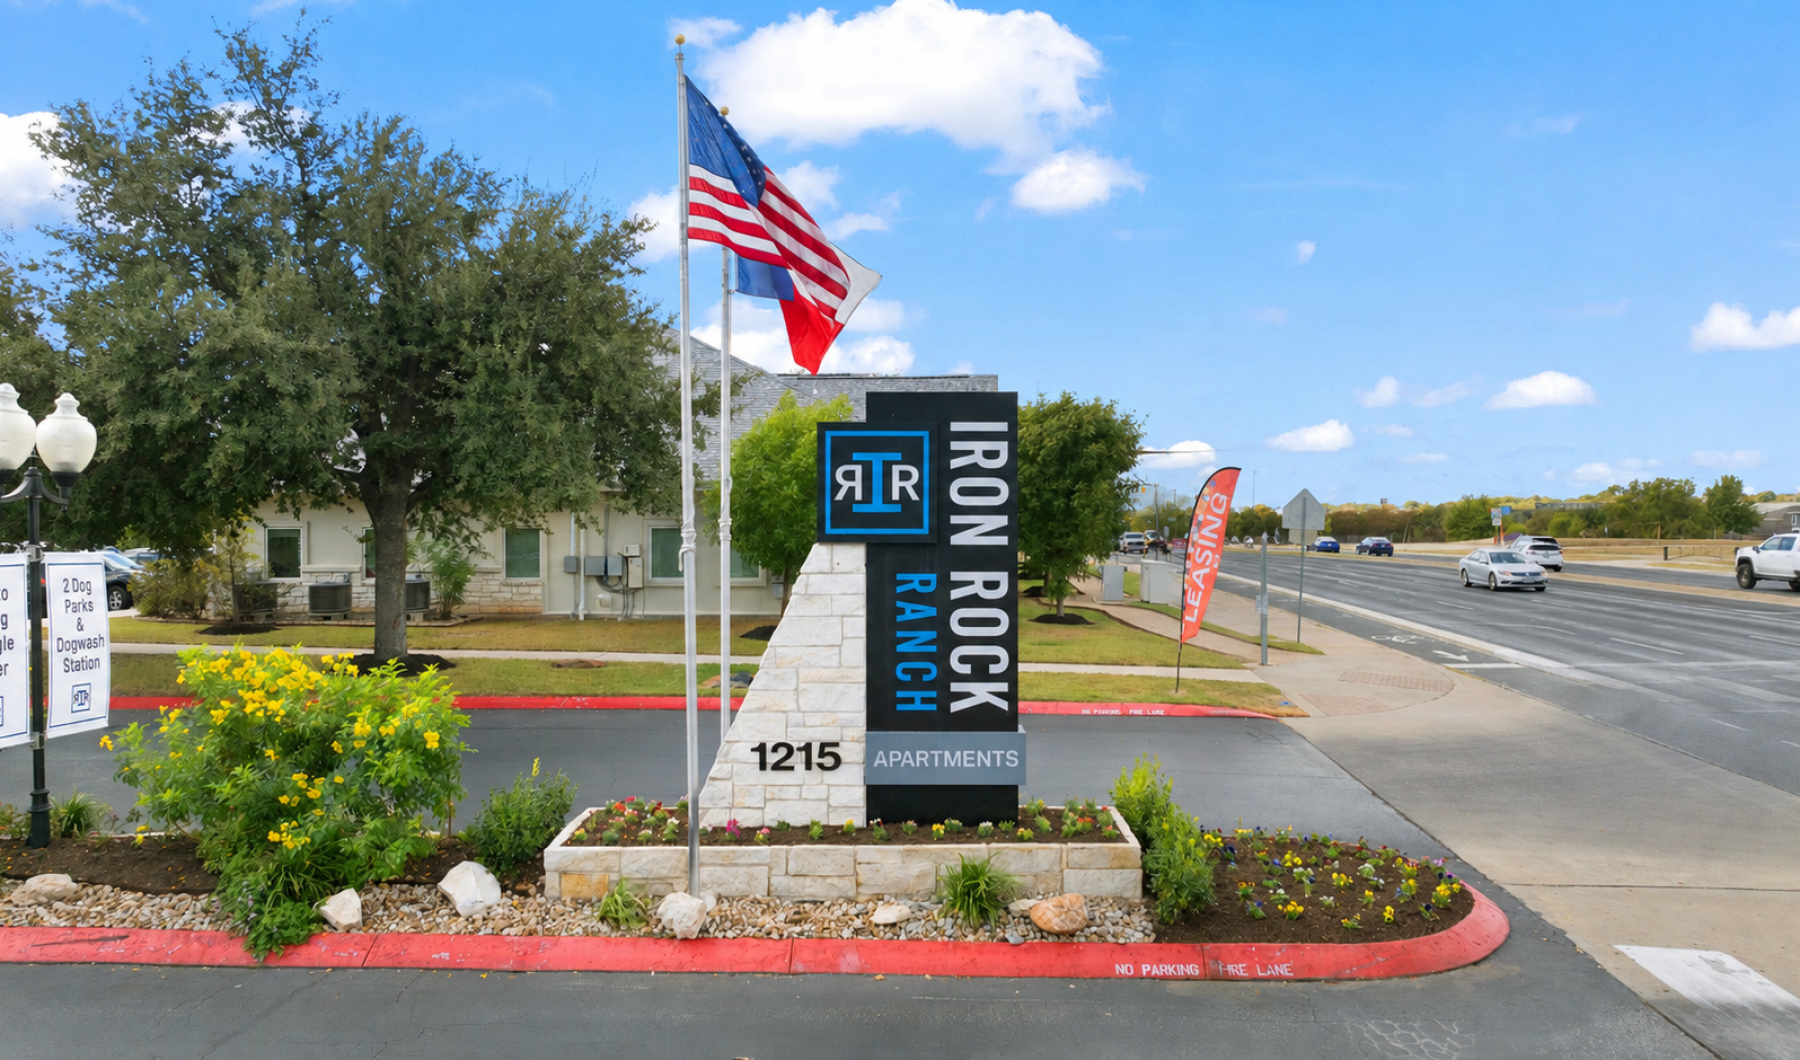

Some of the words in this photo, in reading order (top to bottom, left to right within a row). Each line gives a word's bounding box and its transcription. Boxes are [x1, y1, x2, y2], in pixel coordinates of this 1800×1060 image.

[949, 421, 1009, 546] IRON
[1185, 492, 1228, 623] LEASING
[62, 577, 70, 593] 2
[71, 577, 92, 595] Dog
[64, 598, 94, 614] Parks
[76, 617, 85, 632] &
[56, 634, 105, 654] Dogwash
[895, 572, 938, 712] RANCH
[949, 571, 1009, 713] ROCK
[63, 655, 100, 673] Station
[750, 741, 842, 772] 1215
[873, 749, 1019, 769] APARTMENTS
[1114, 963, 1134, 976] NO
[1141, 963, 1200, 976] PARKING
[1256, 963, 1295, 977] LANE
